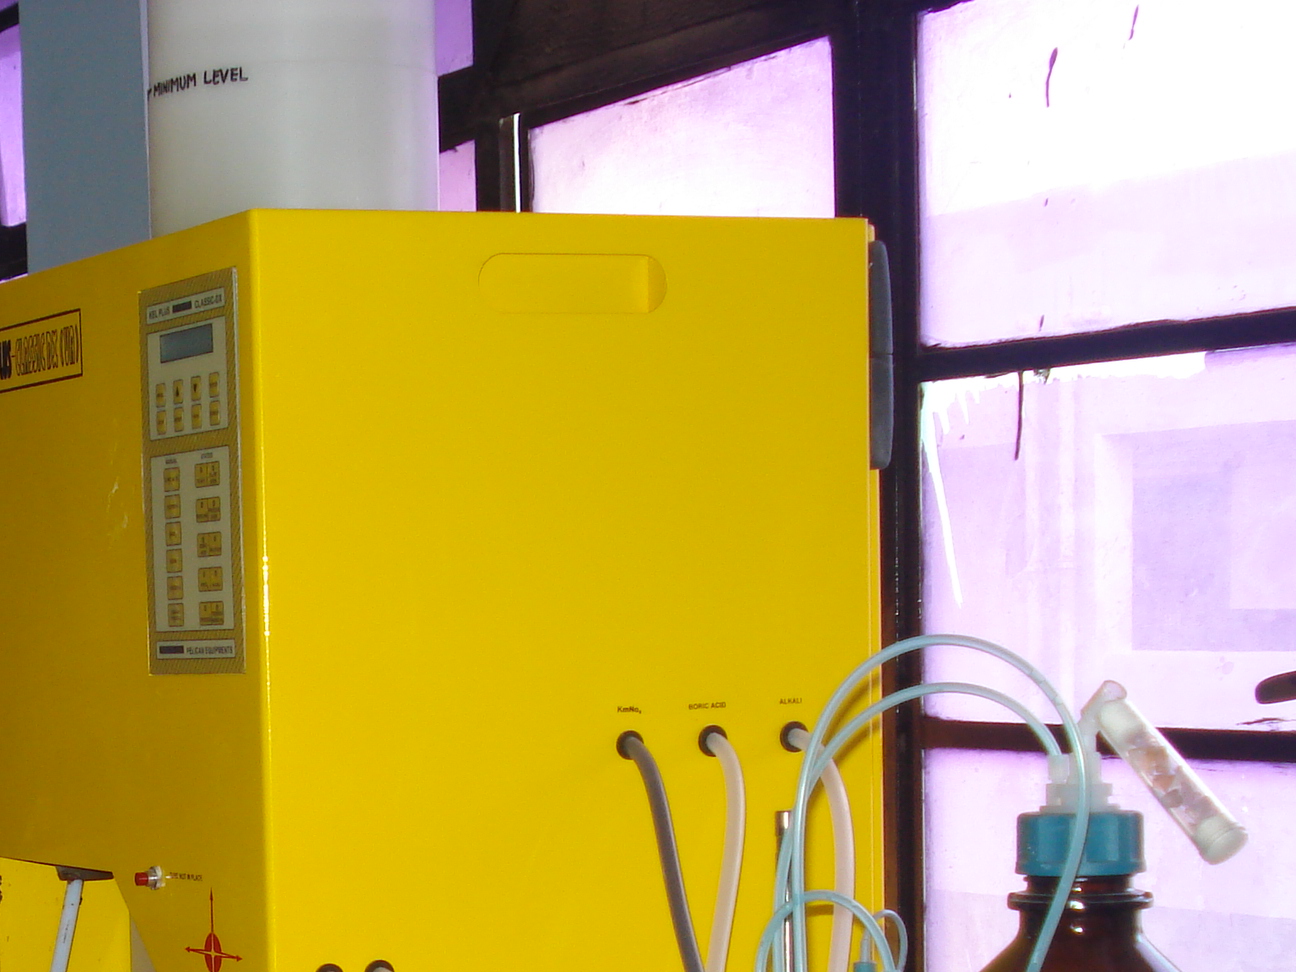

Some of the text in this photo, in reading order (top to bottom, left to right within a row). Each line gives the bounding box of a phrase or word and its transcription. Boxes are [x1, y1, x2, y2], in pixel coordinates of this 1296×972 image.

[153, 66, 249, 97] MINIMUM LEVEL
[688, 701, 726, 710] BORIC ACID
[779, 697, 803, 705] ALKALI
